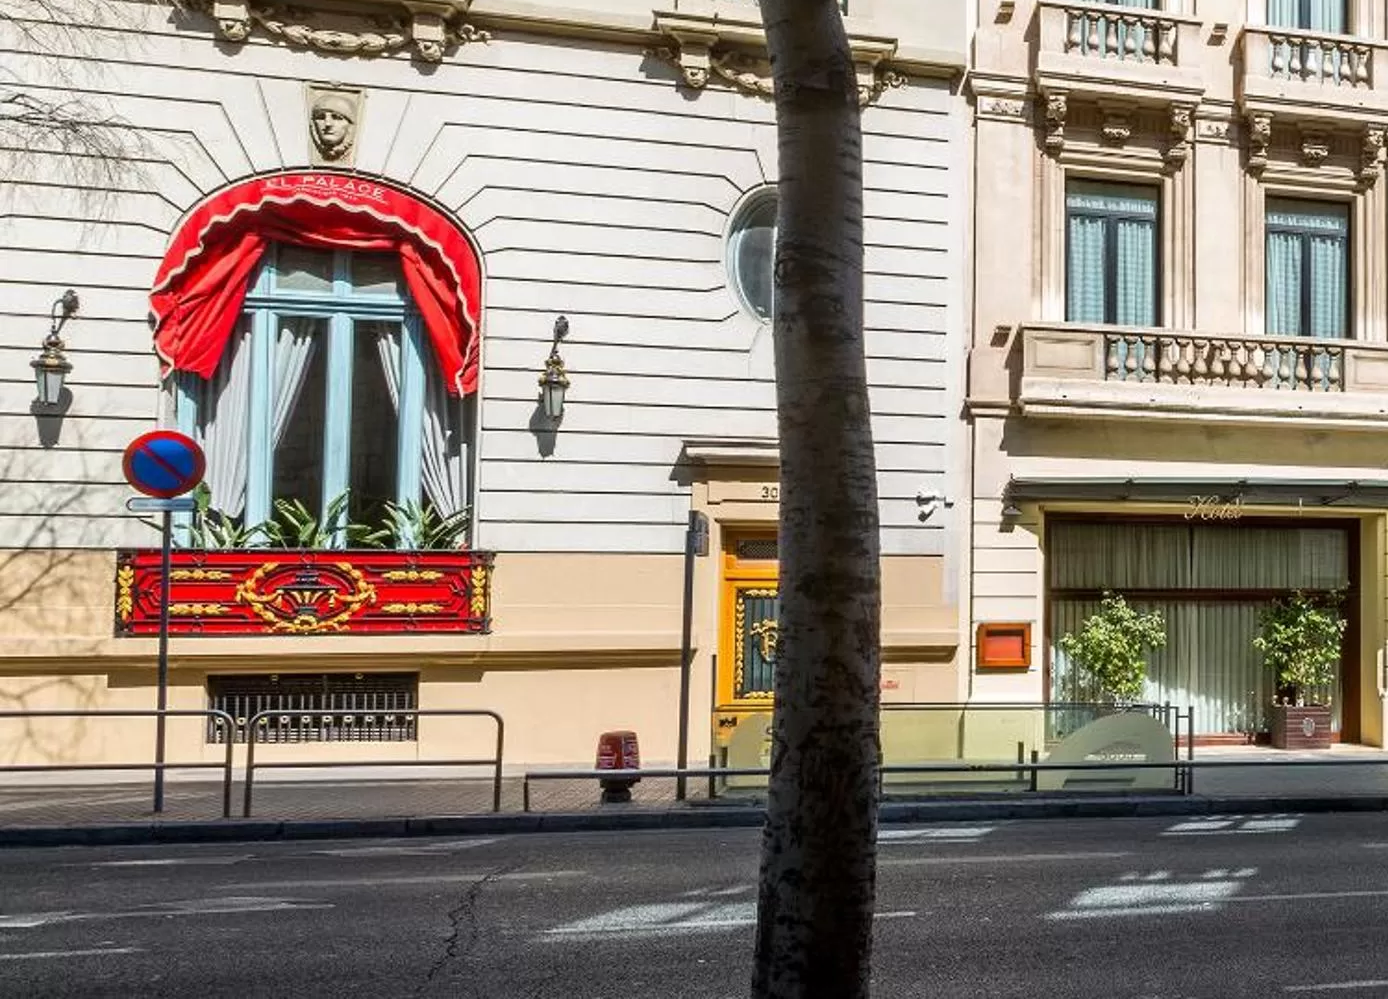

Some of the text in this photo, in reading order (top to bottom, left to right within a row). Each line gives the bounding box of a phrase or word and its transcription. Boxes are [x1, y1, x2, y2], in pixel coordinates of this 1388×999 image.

[265, 176, 292, 189] EL
[302, 175, 385, 197] PALACE
[761, 485, 779, 498] 30
[1184, 492, 1243, 520] Hotel
